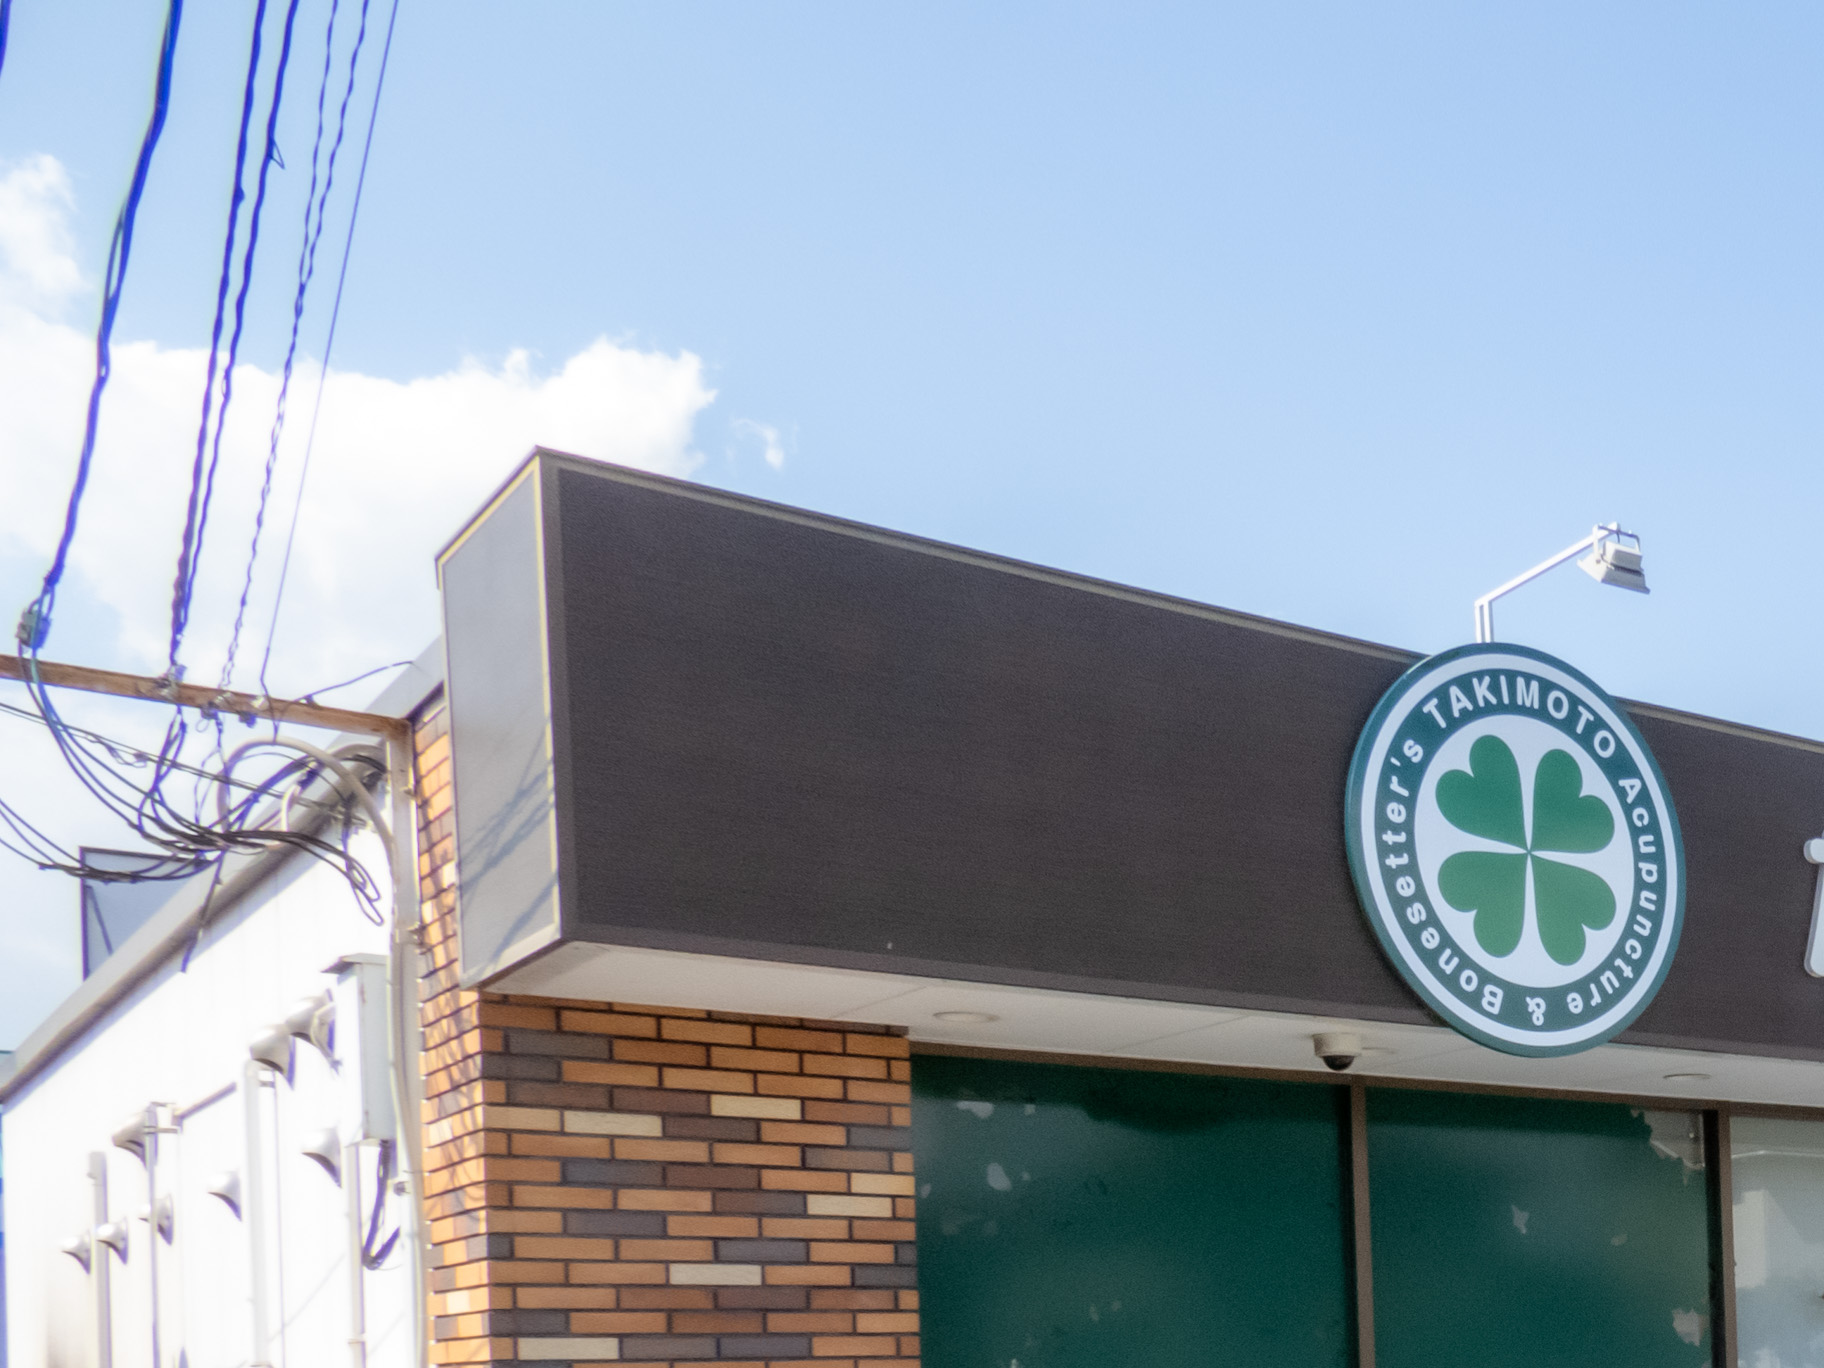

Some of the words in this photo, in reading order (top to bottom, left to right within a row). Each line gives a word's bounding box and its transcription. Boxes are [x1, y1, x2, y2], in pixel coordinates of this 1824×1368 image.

[1423, 675, 1617, 760] TAKIMOTO
[1381, 738, 1504, 1016] Bonesetter's
[1566, 777, 1659, 1015] Acupuncture
[1525, 996, 1547, 1026] &
